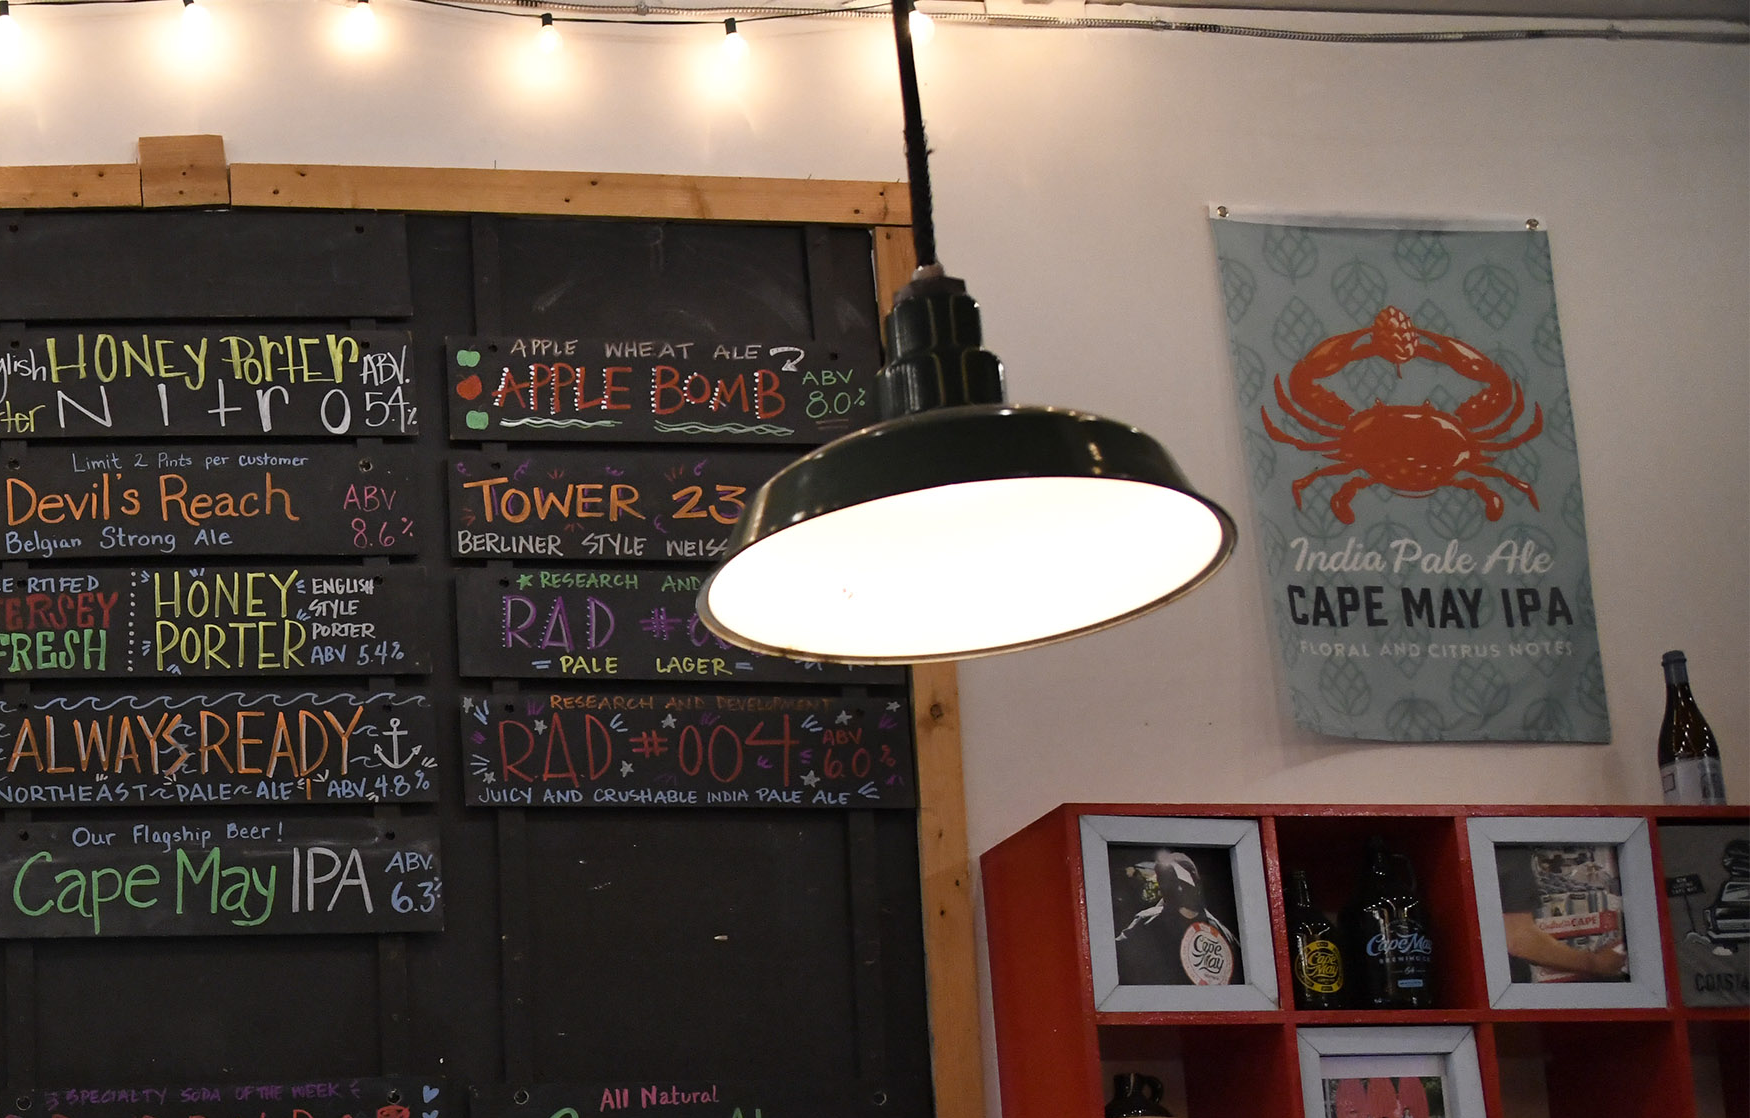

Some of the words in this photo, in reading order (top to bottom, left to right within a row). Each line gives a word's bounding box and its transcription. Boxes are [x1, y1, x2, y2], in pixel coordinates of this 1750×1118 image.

[510, 339, 579, 357] APPLE
[604, 342, 694, 359] WHEAT
[714, 344, 762, 359] ALE
[492, 362, 632, 415] APPLE
[650, 365, 786, 419] BOMB
[802, 369, 854, 386] ABV
[5, 472, 141, 526] Devil's
[159, 472, 299, 526] Reach
[343, 484, 396, 512] ABV
[463, 476, 646, 522] TOWER
[671, 484, 746, 525] 23
[5, 530, 82, 558] Belgian
[100, 527, 177, 553] Strong
[194, 529, 233, 546] Ale
[352, 517, 414, 549] 8.6%
[457, 530, 564, 556] BERLINER
[581, 533, 647, 555] STYLE
[1290, 536, 1387, 574] India
[1390, 537, 1478, 576] Pale
[1482, 538, 1554, 575] Ale
[154, 569, 298, 619] HONEY
[312, 577, 375, 594] ENGLISH
[308, 599, 360, 617] STYLE
[1287, 584, 1389, 628] CAPE
[1400, 586, 1483, 630] MAY
[1501, 586, 1574, 629] IPA
[312, 622, 375, 640] PORTER
[155, 621, 306, 672] PORTER
[1300, 642, 1371, 658] FLORAL
[1380, 642, 1420, 658] AND
[1428, 644, 1500, 659] CITRUS
[1509, 642, 1573, 657] NOTES
[560, 656, 619, 675] PALE
[656, 658, 733, 676] LAGER
[629, 713, 800, 788] #004
[822, 728, 863, 746] ABV
[478, 788, 532, 805] JUICY
[542, 790, 583, 804] AND
[593, 789, 698, 805] CRUSHABLE
[707, 790, 749, 803] INDIA
[756, 789, 802, 804] PALE
[812, 791, 850, 805] ALE
[12, 850, 160, 935] Cape
[176, 847, 277, 927] May
[291, 847, 373, 914] IPA
[600, 1087, 629, 1112] All
[641, 1084, 720, 1109] Natural
